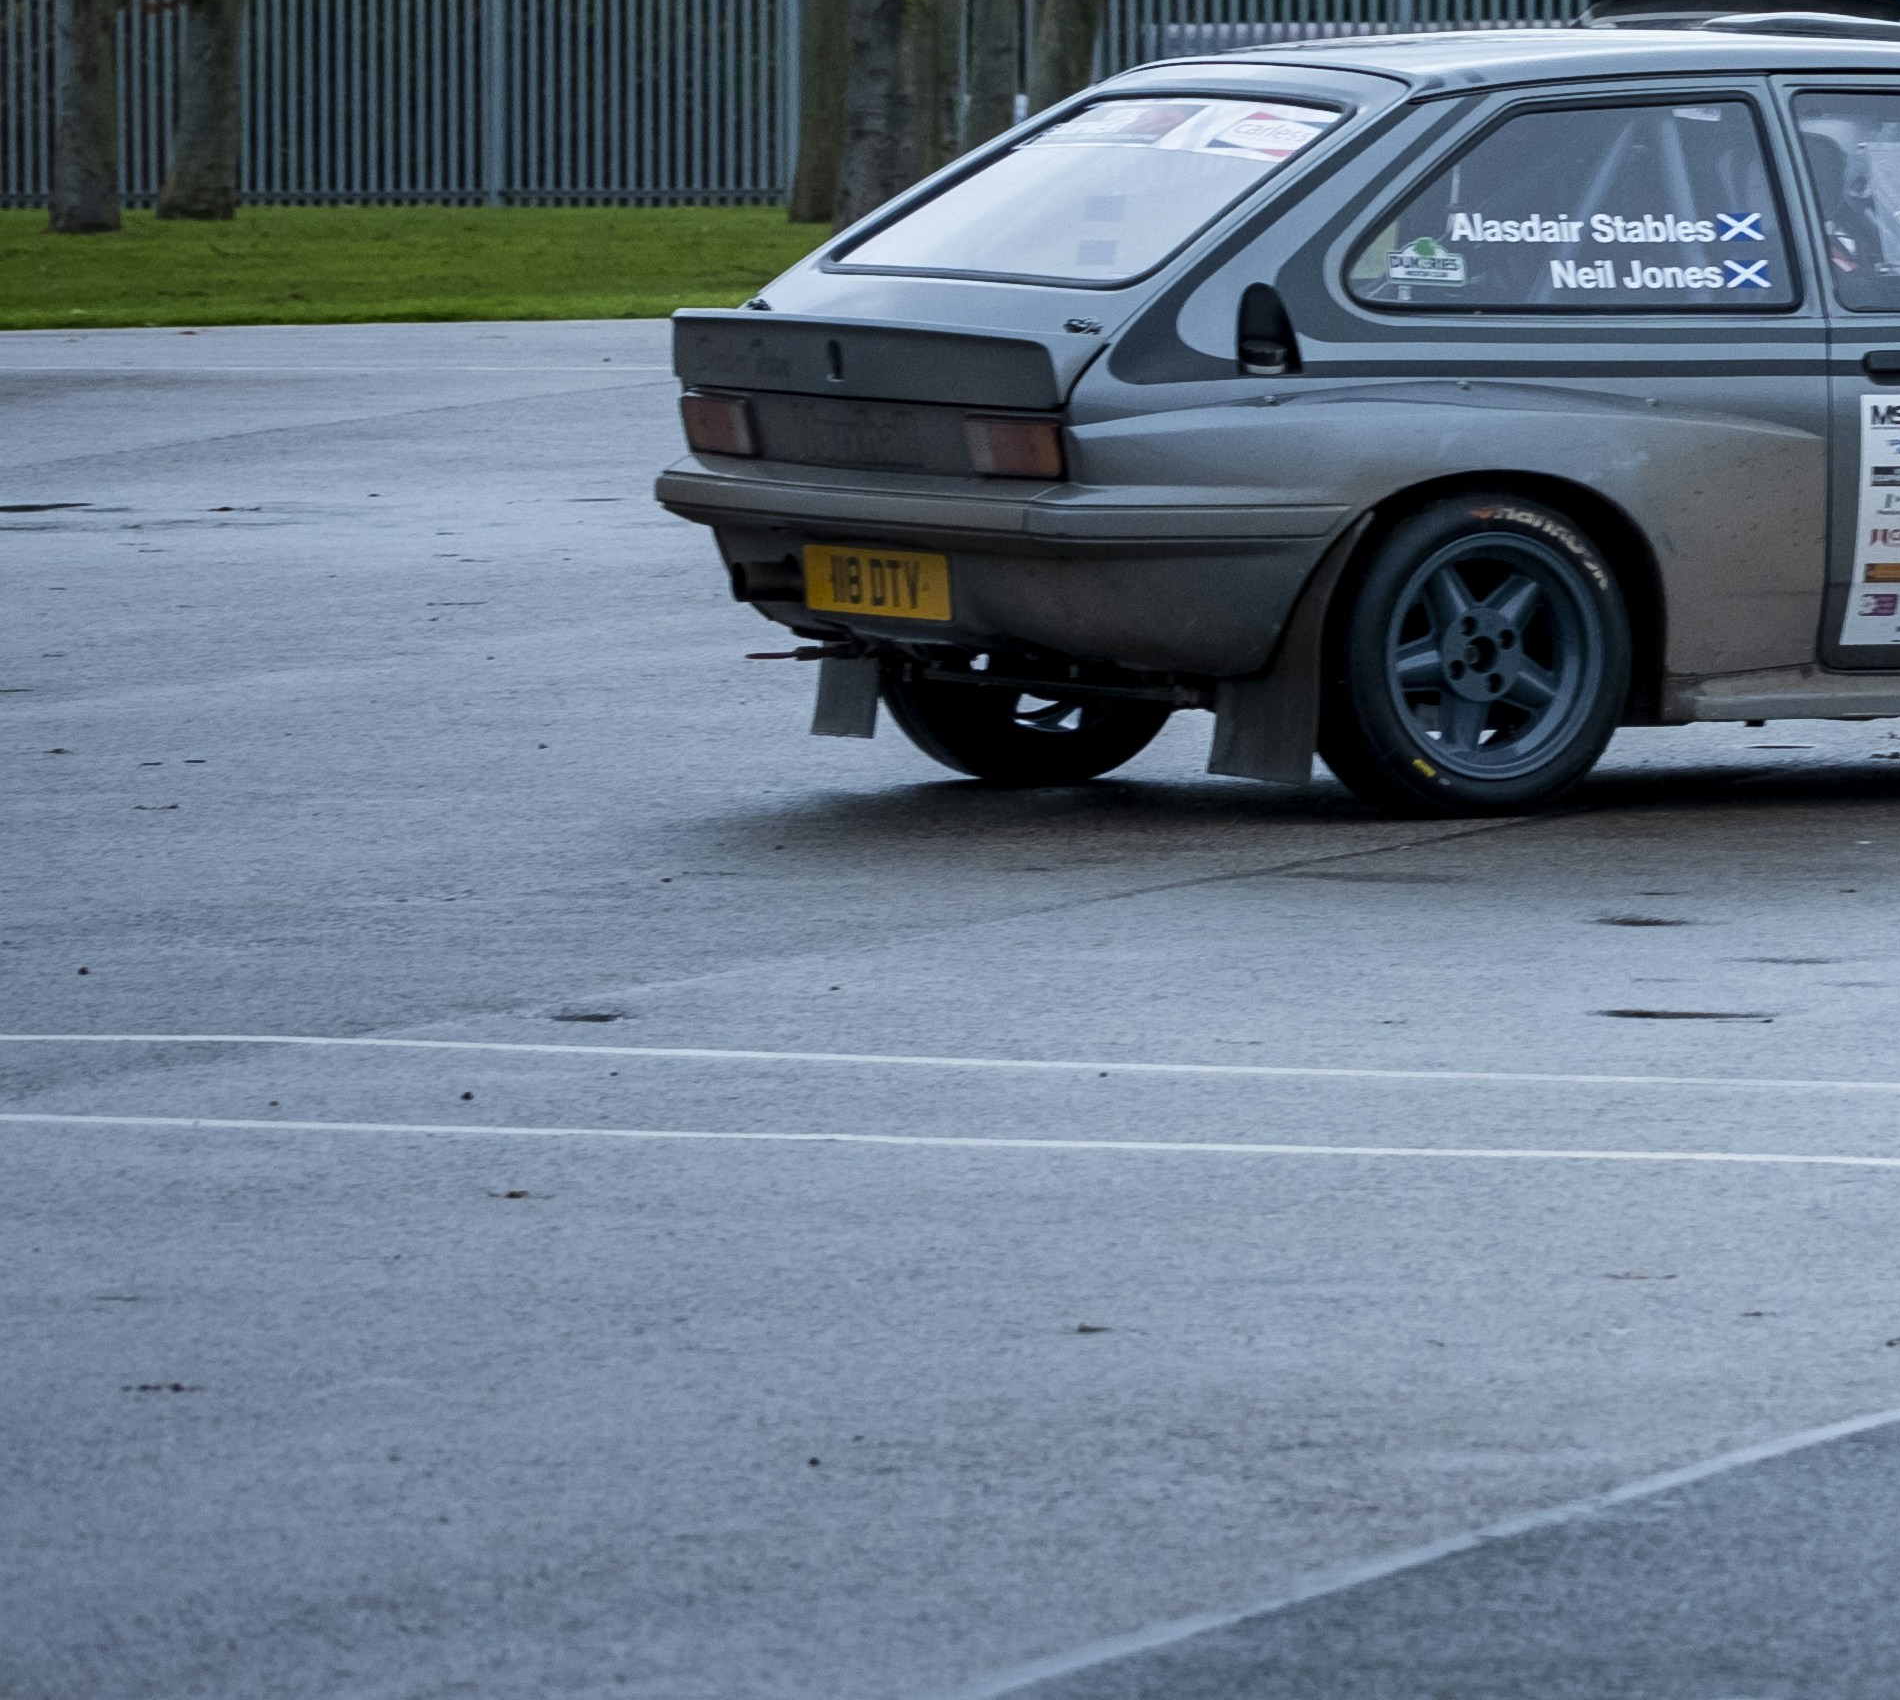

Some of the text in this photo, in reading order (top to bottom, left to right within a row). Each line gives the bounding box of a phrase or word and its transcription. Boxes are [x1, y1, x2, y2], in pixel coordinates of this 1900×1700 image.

[1450, 212, 1717, 244] Alasdair Stables
[1550, 260, 1725, 290] Neil Jones
[868, 558, 921, 610] DTV
